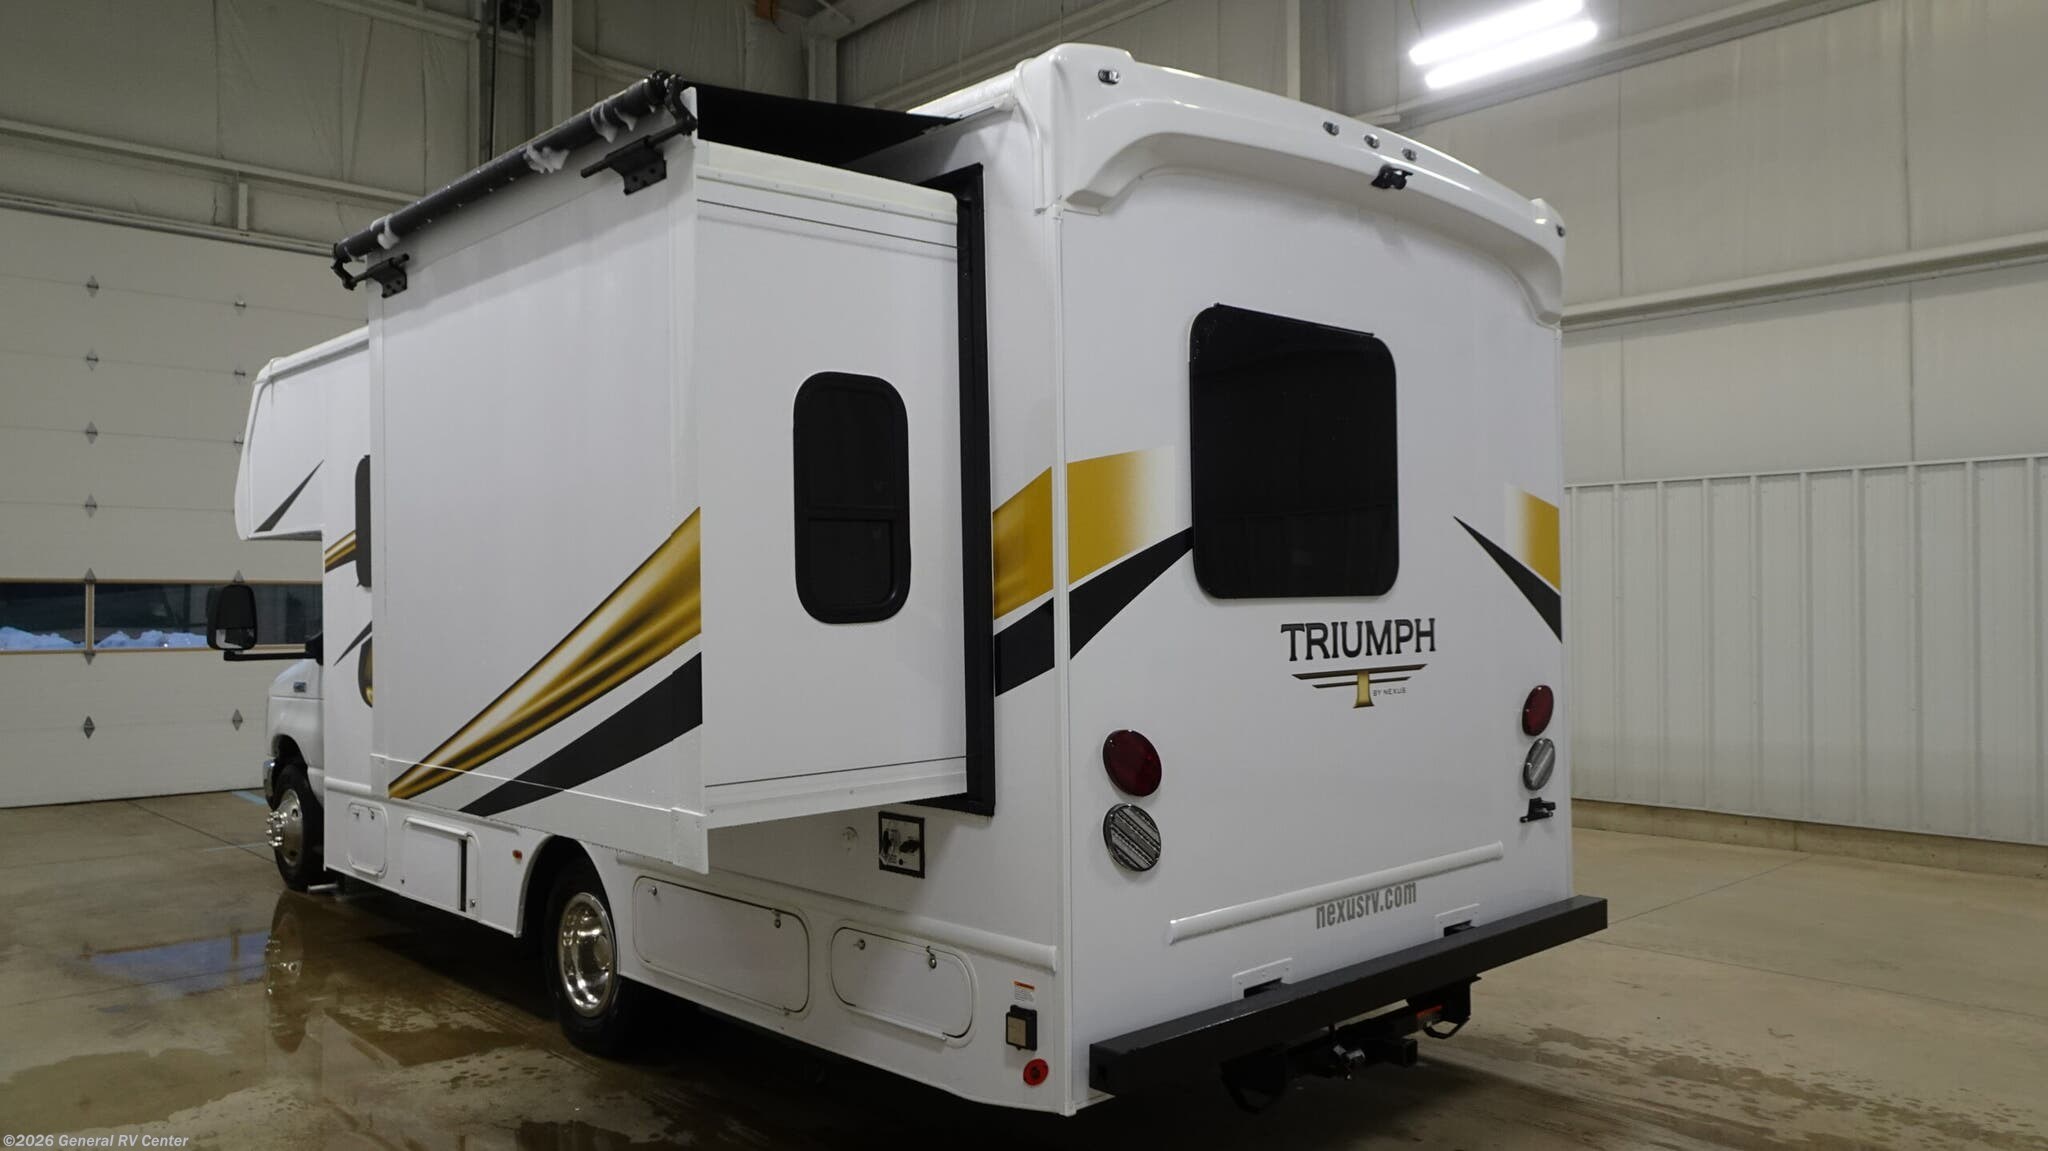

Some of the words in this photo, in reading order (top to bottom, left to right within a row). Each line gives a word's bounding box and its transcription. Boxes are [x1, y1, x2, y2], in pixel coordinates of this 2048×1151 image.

[1280, 618, 1437, 661] TRIUMPH
[1373, 689, 1382, 697] BY
[1383, 687, 1407, 696] NEXUS
[1316, 882, 1417, 929] nexusrv.com
